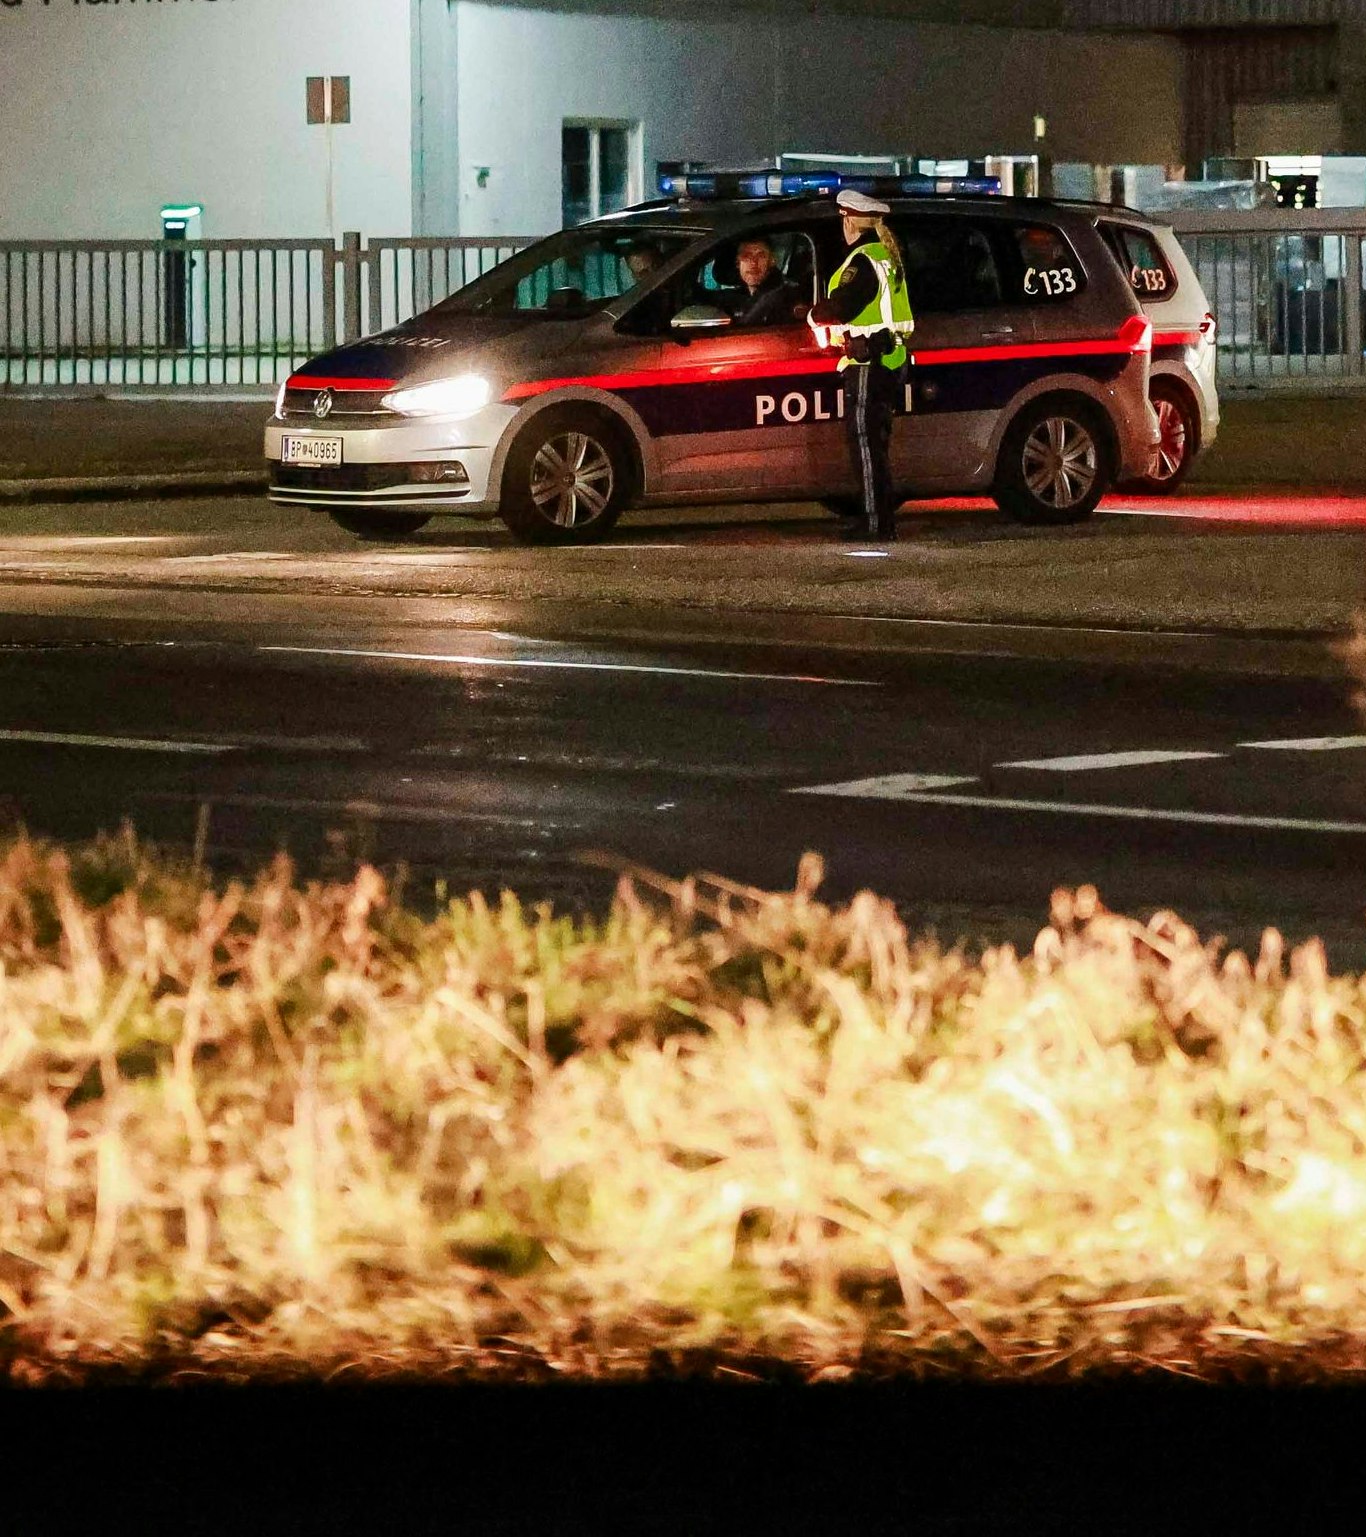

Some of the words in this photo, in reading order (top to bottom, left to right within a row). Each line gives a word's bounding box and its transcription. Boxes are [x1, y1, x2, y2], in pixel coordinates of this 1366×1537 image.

[1039, 268, 1076, 295] 133
[1141, 269, 1166, 291] 133
[756, 384, 912, 425] POLII
